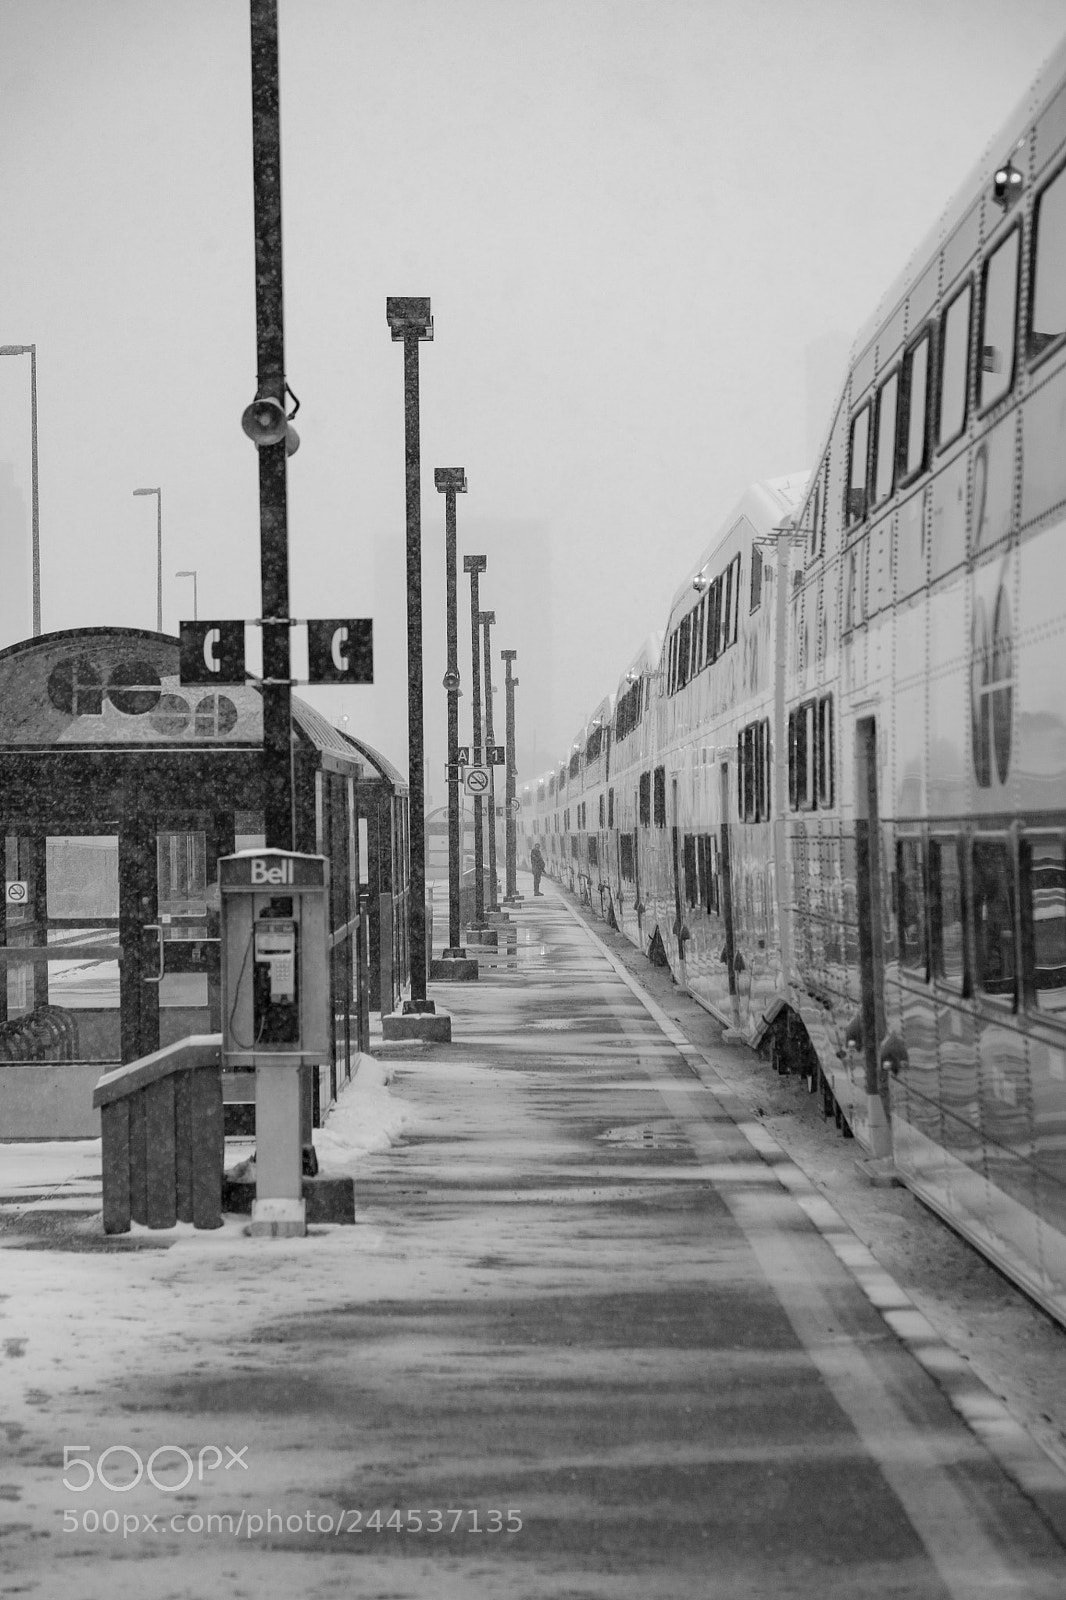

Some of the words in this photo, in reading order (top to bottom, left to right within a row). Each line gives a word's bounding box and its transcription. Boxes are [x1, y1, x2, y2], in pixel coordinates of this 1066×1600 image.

[458, 749, 467, 761] A
[492, 749, 498, 761] 1
[251, 859, 294, 884] Bell
